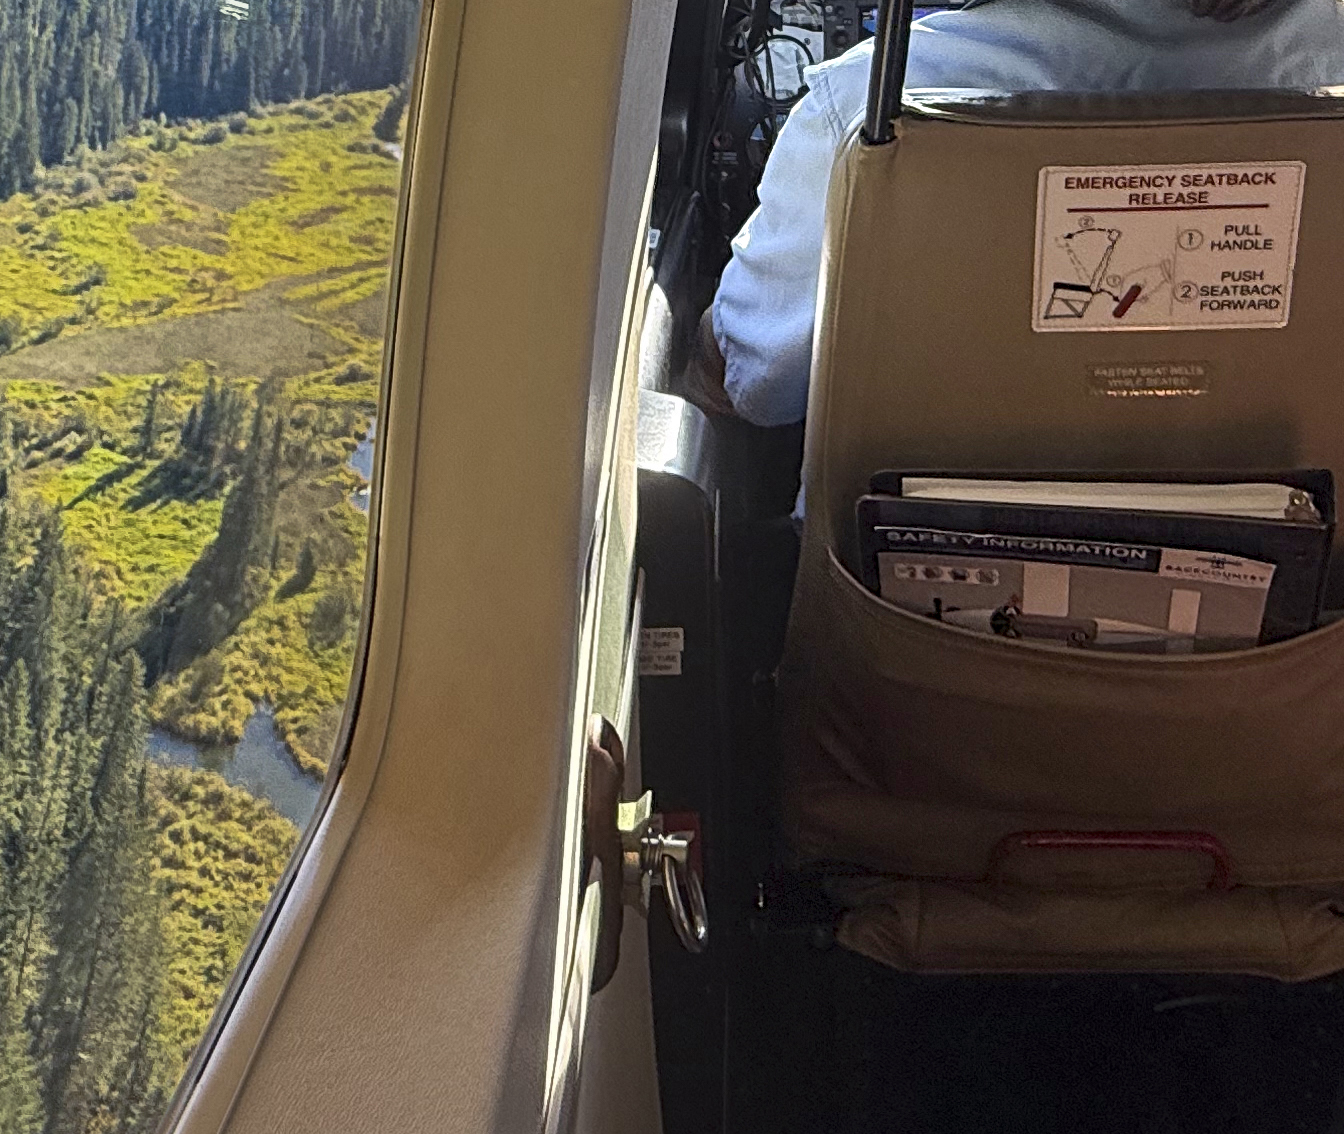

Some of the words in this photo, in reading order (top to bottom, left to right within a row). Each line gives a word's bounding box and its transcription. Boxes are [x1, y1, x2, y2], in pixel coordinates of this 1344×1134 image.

[1064, 175, 1176, 189] EMERGENCY
[1180, 172, 1277, 186] SEATBACK
[1128, 191, 1210, 205] RELEASE
[1224, 224, 1262, 236] PULL
[1210, 239, 1274, 251] HANDLE
[1220, 270, 1265, 282] PUSH
[1199, 284, 1282, 296] SEATBACK
[1199, 298, 1281, 311] FORWARD
[885, 530, 975, 545] SAFETY
[982, 536, 1147, 560] INFORMATION
